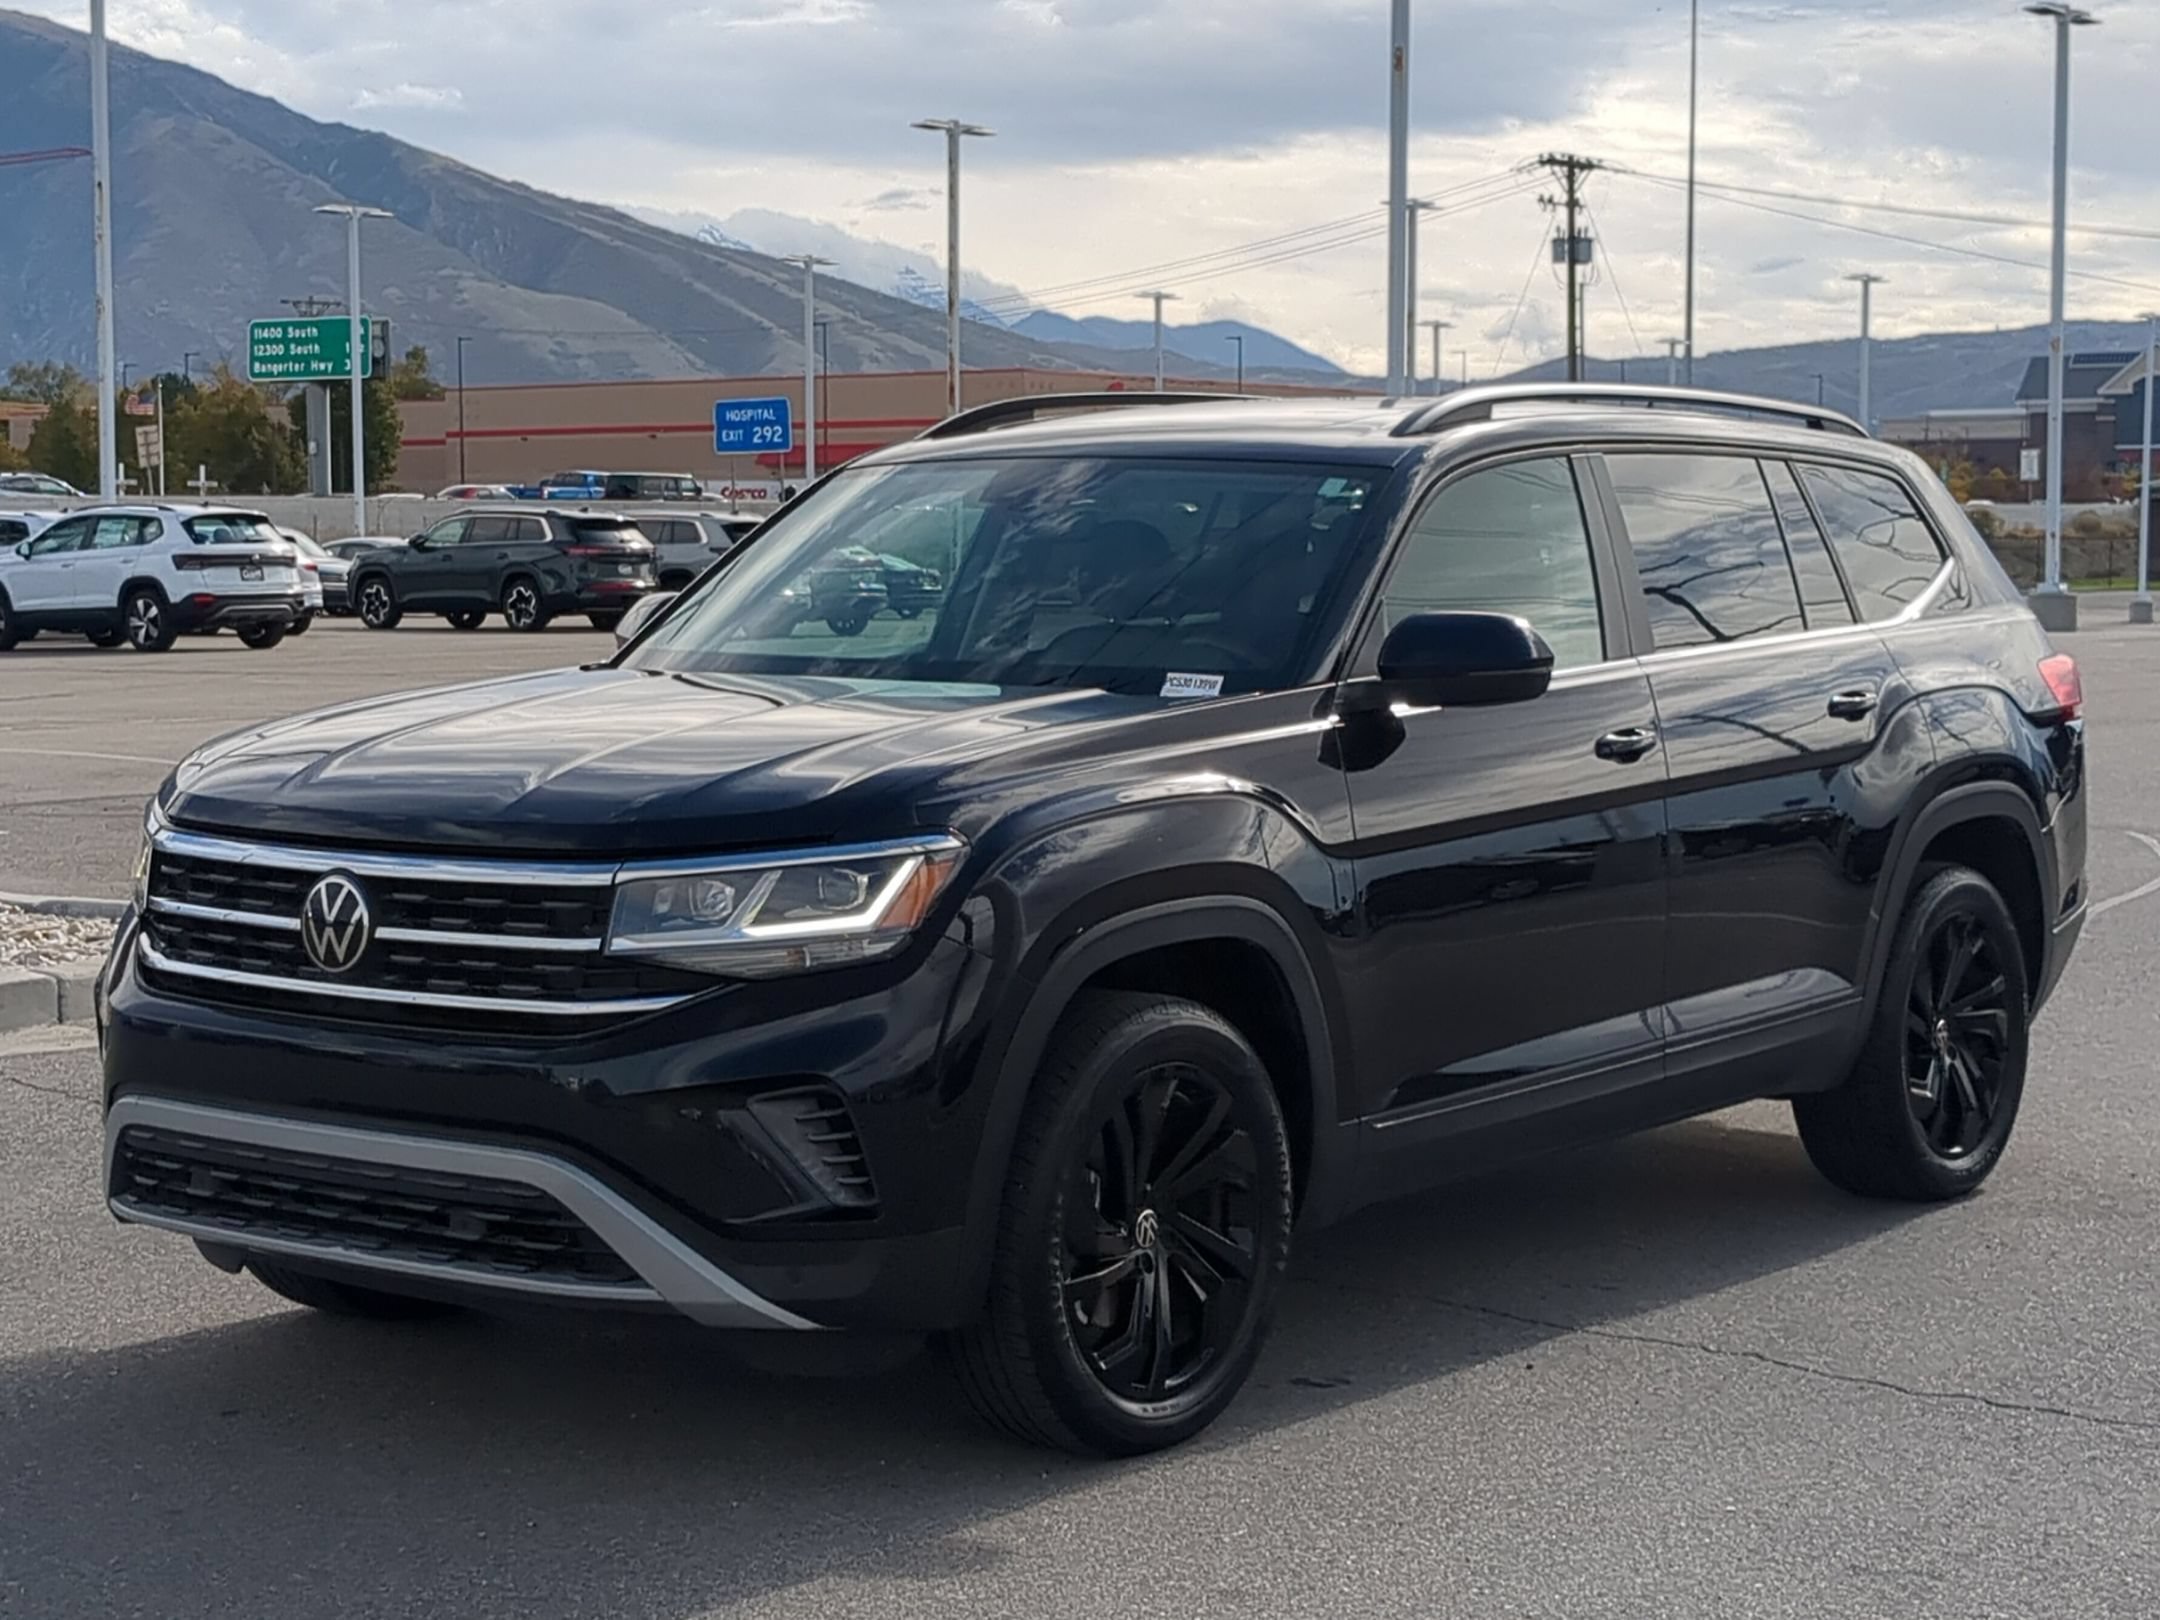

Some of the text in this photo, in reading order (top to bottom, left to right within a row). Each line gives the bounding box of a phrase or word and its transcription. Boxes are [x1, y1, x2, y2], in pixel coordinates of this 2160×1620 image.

[254, 326, 319, 339] 11400 South
[254, 344, 285, 356] 12300
[290, 343, 320, 355] South
[254, 361, 305, 376] Bangerter
[310, 360, 334, 373] Hwy
[726, 408, 776, 422] HOSPITAL
[722, 425, 783, 443] EXIT 292
